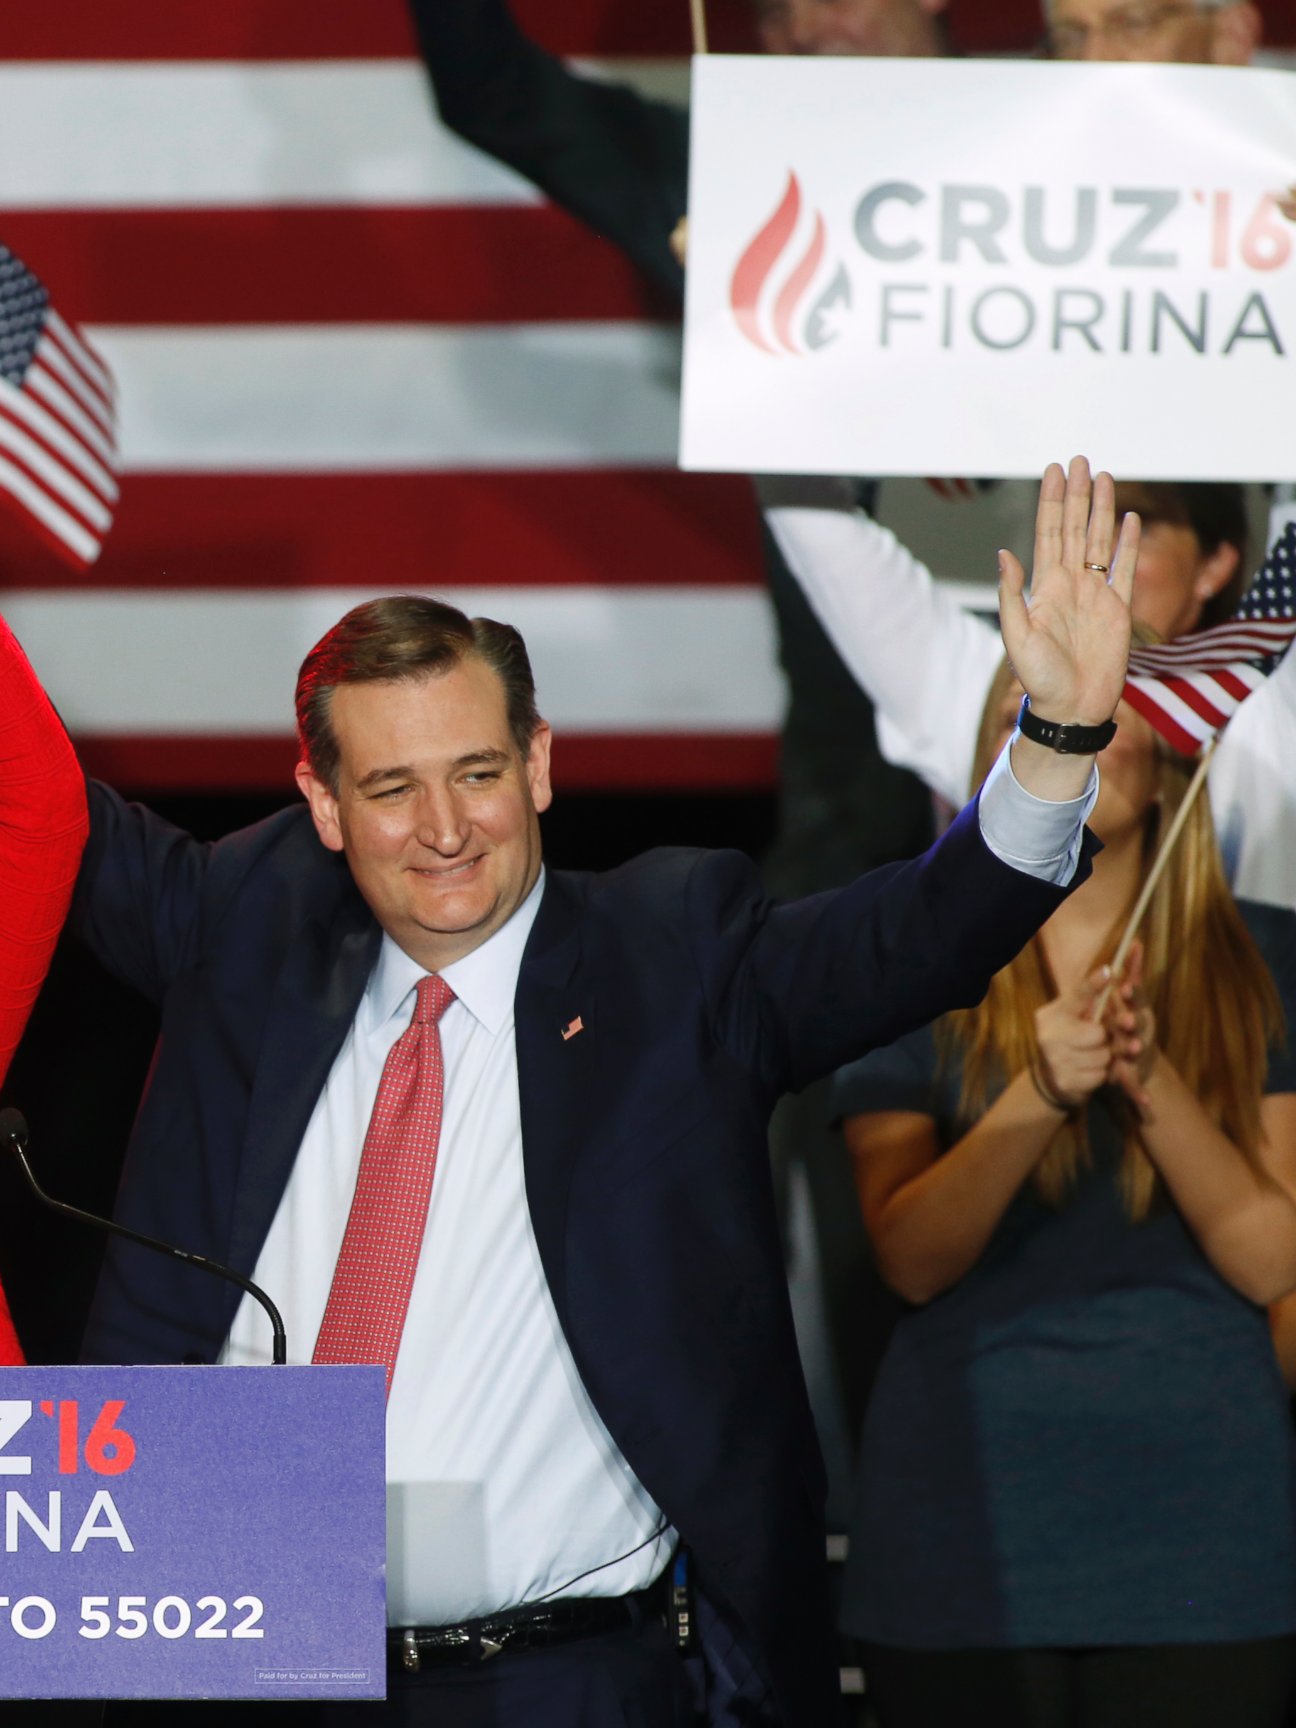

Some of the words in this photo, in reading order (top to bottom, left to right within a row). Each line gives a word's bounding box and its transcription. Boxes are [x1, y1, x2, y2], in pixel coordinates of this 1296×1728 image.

[853, 180, 1180, 268] CRUZ
[879, 283, 1286, 357] FIORINA
[77, 1595, 266, 1641] 55022
[258, 1671, 276, 1680] Paid
[277, 1671, 288, 1681] for
[289, 1671, 300, 1682] by
[300, 1671, 318, 1680] Cruz
[319, 1671, 330, 1680] for
[331, 1671, 367, 1680] President
